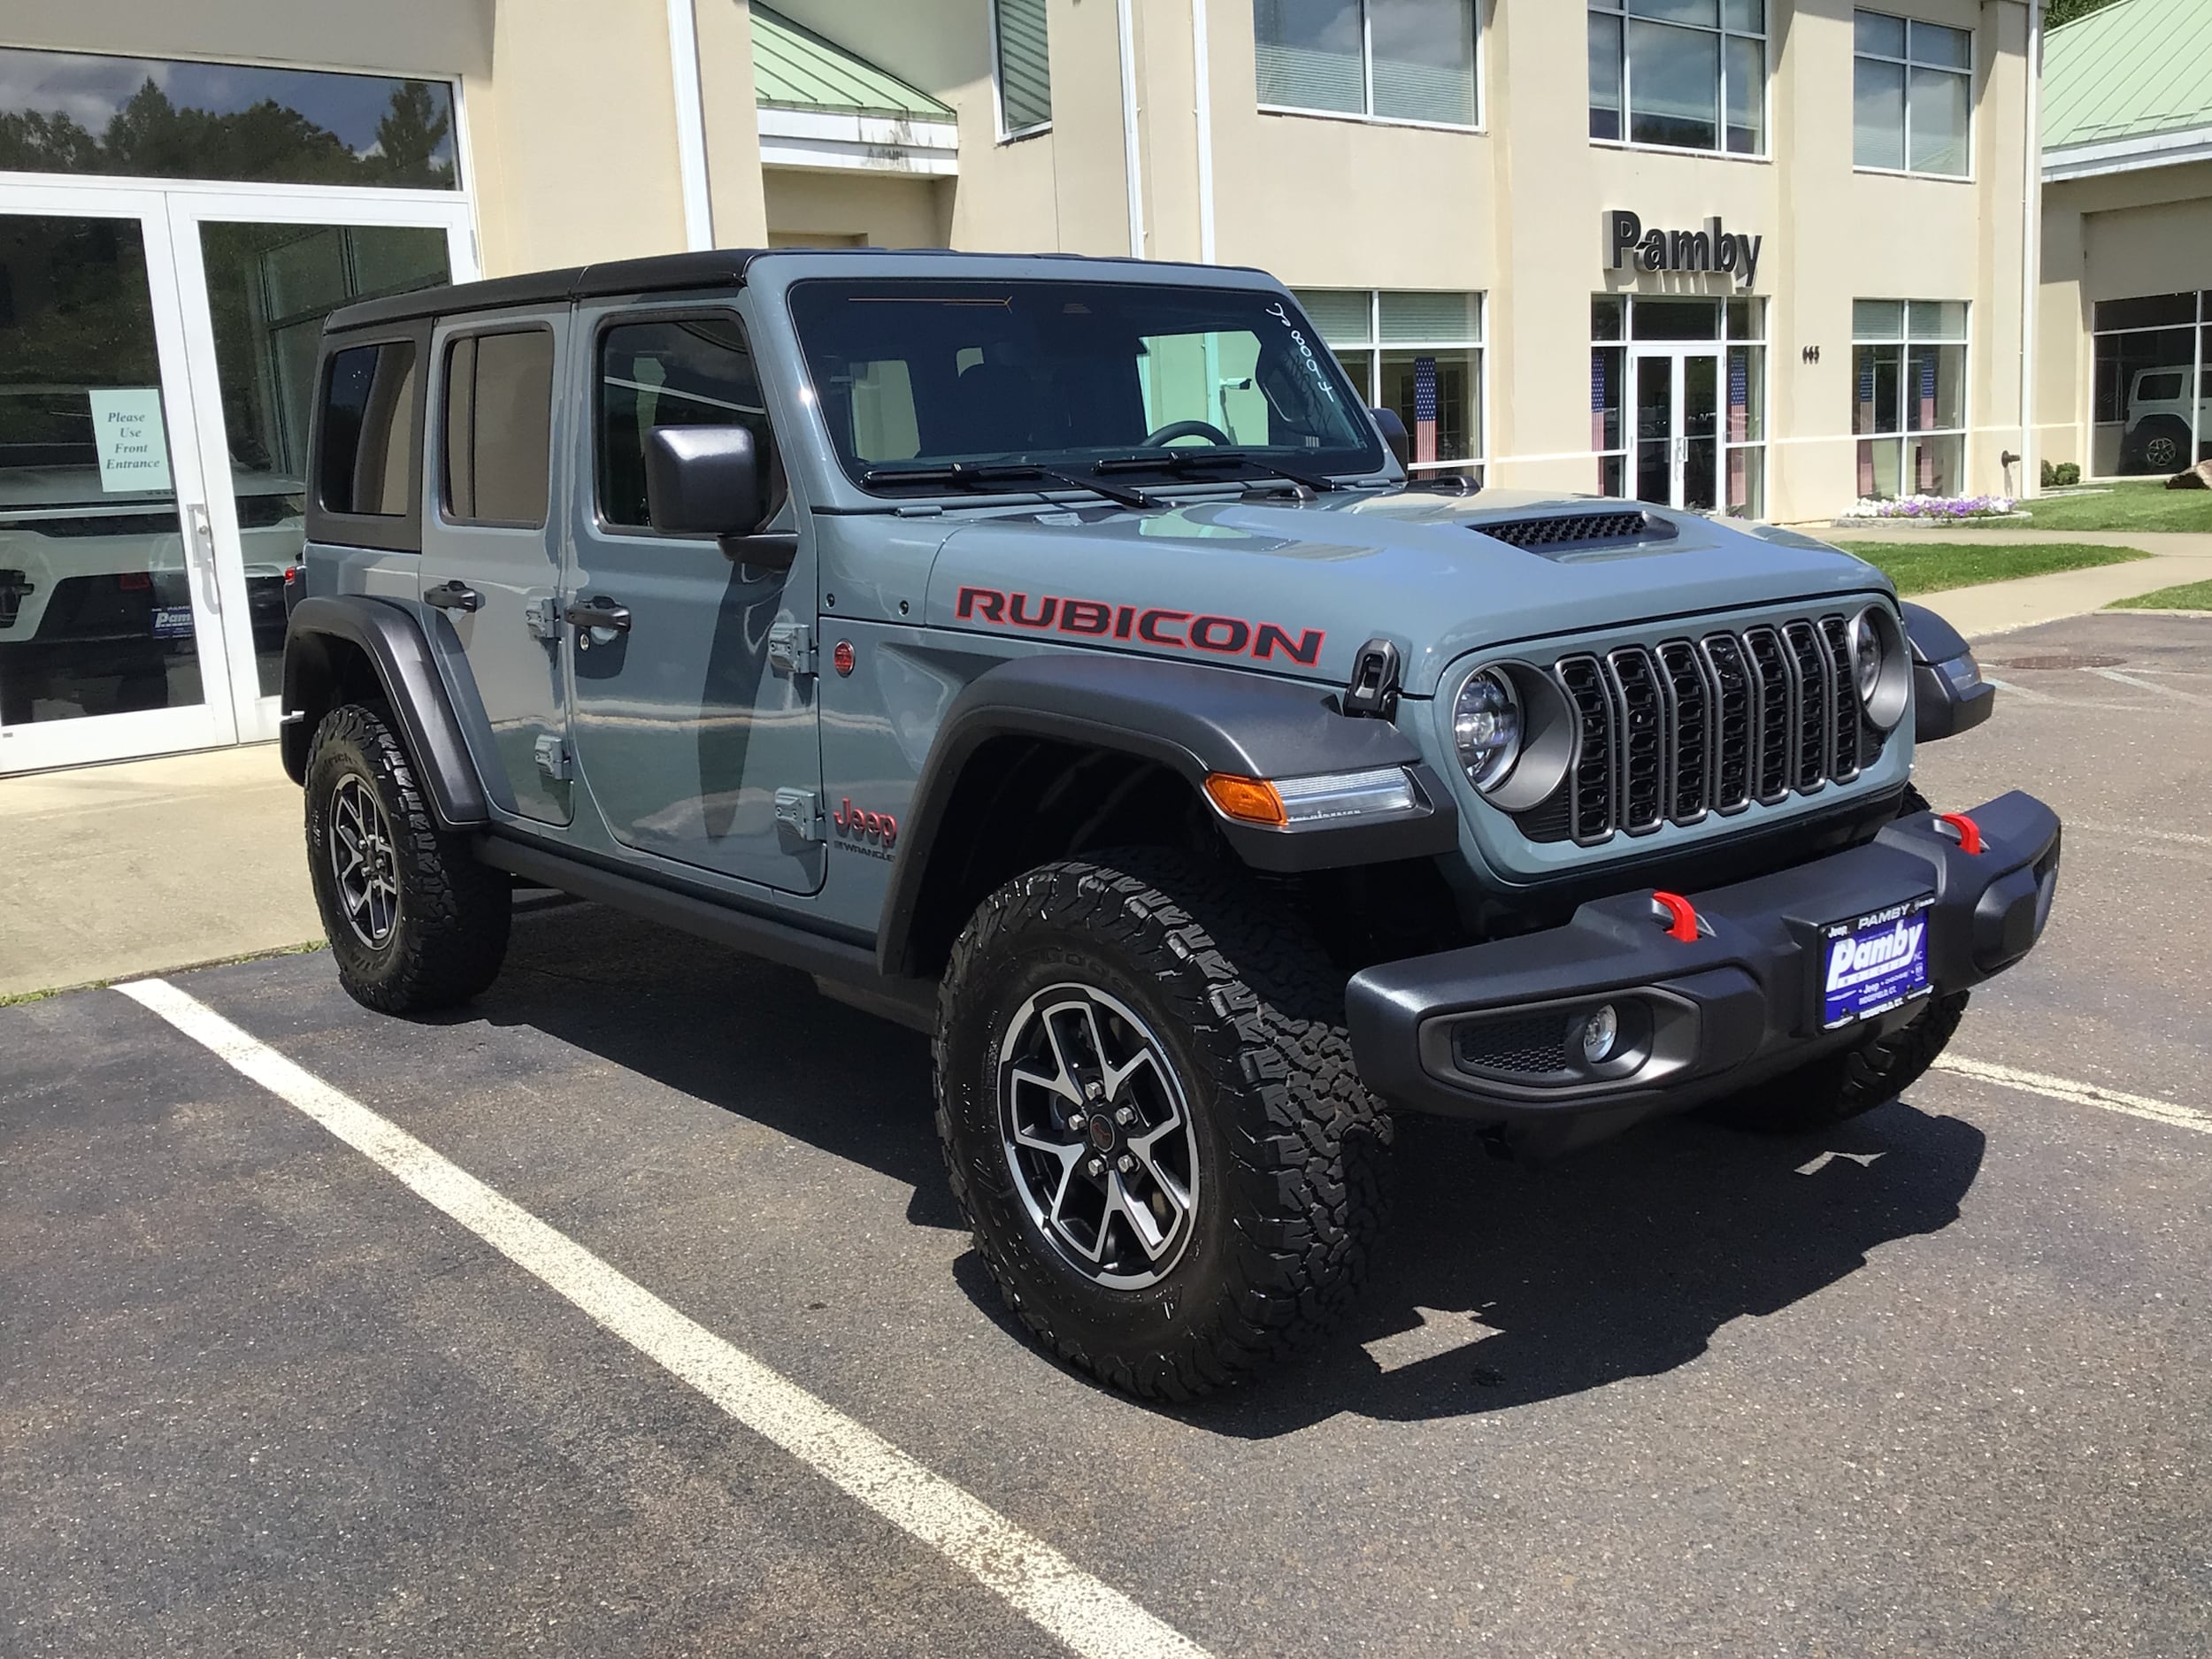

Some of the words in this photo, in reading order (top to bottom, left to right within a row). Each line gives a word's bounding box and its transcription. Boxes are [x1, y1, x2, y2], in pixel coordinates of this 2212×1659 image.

[1602, 210, 1763, 288] Pamby
[107, 412, 145, 423] Please
[119, 427, 142, 438] Use
[115, 442, 148, 454] Front
[106, 458, 160, 470] Entrance
[154, 612, 192, 628] Pam
[955, 585, 1326, 667] RUBICON
[833, 796, 897, 849] Jeep
[843, 842, 895, 863] WRANGLE
[1857, 903, 1911, 930] PAMBY
[1825, 919, 1924, 993] Pamby
